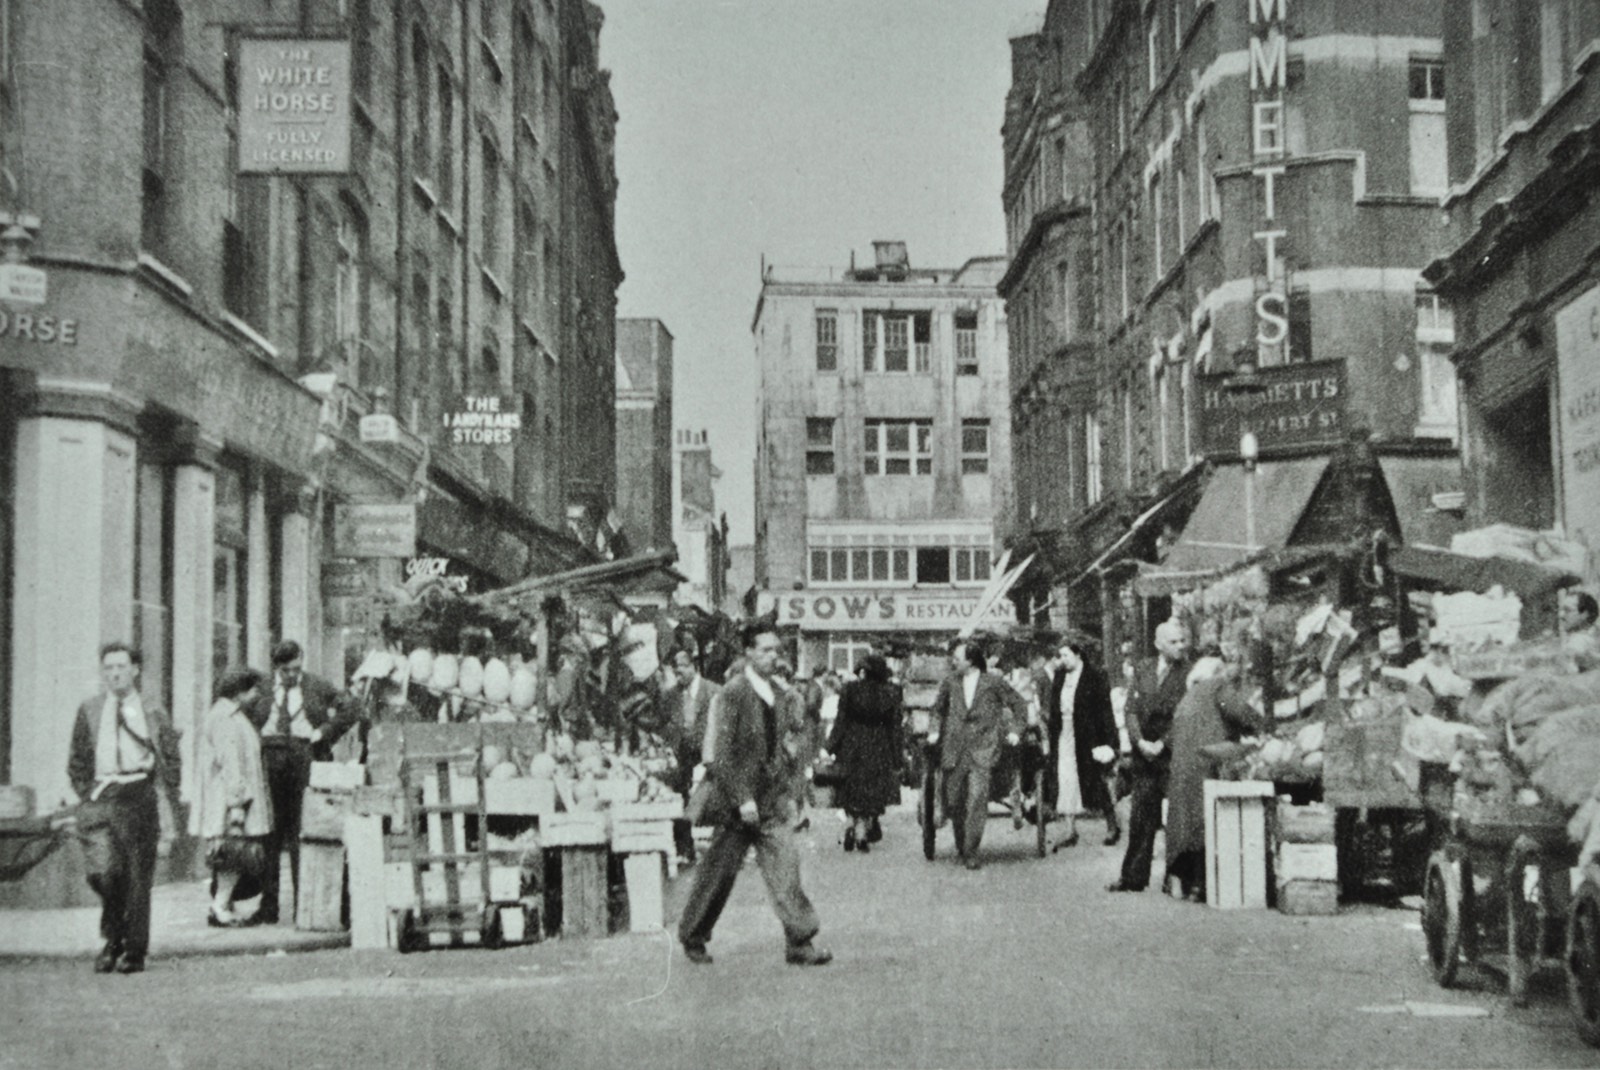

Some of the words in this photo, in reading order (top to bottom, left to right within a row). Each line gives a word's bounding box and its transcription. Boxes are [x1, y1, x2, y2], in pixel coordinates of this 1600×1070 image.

[256, 66, 331, 85] WHITE
[254, 92, 336, 111] HORSE
[266, 131, 322, 144] FULLY
[253, 149, 336, 162] LICENSED
[465, 396, 500, 412] THE
[452, 428, 512, 444] STORES
[906, 603, 1015, 620] RESTAUAN
